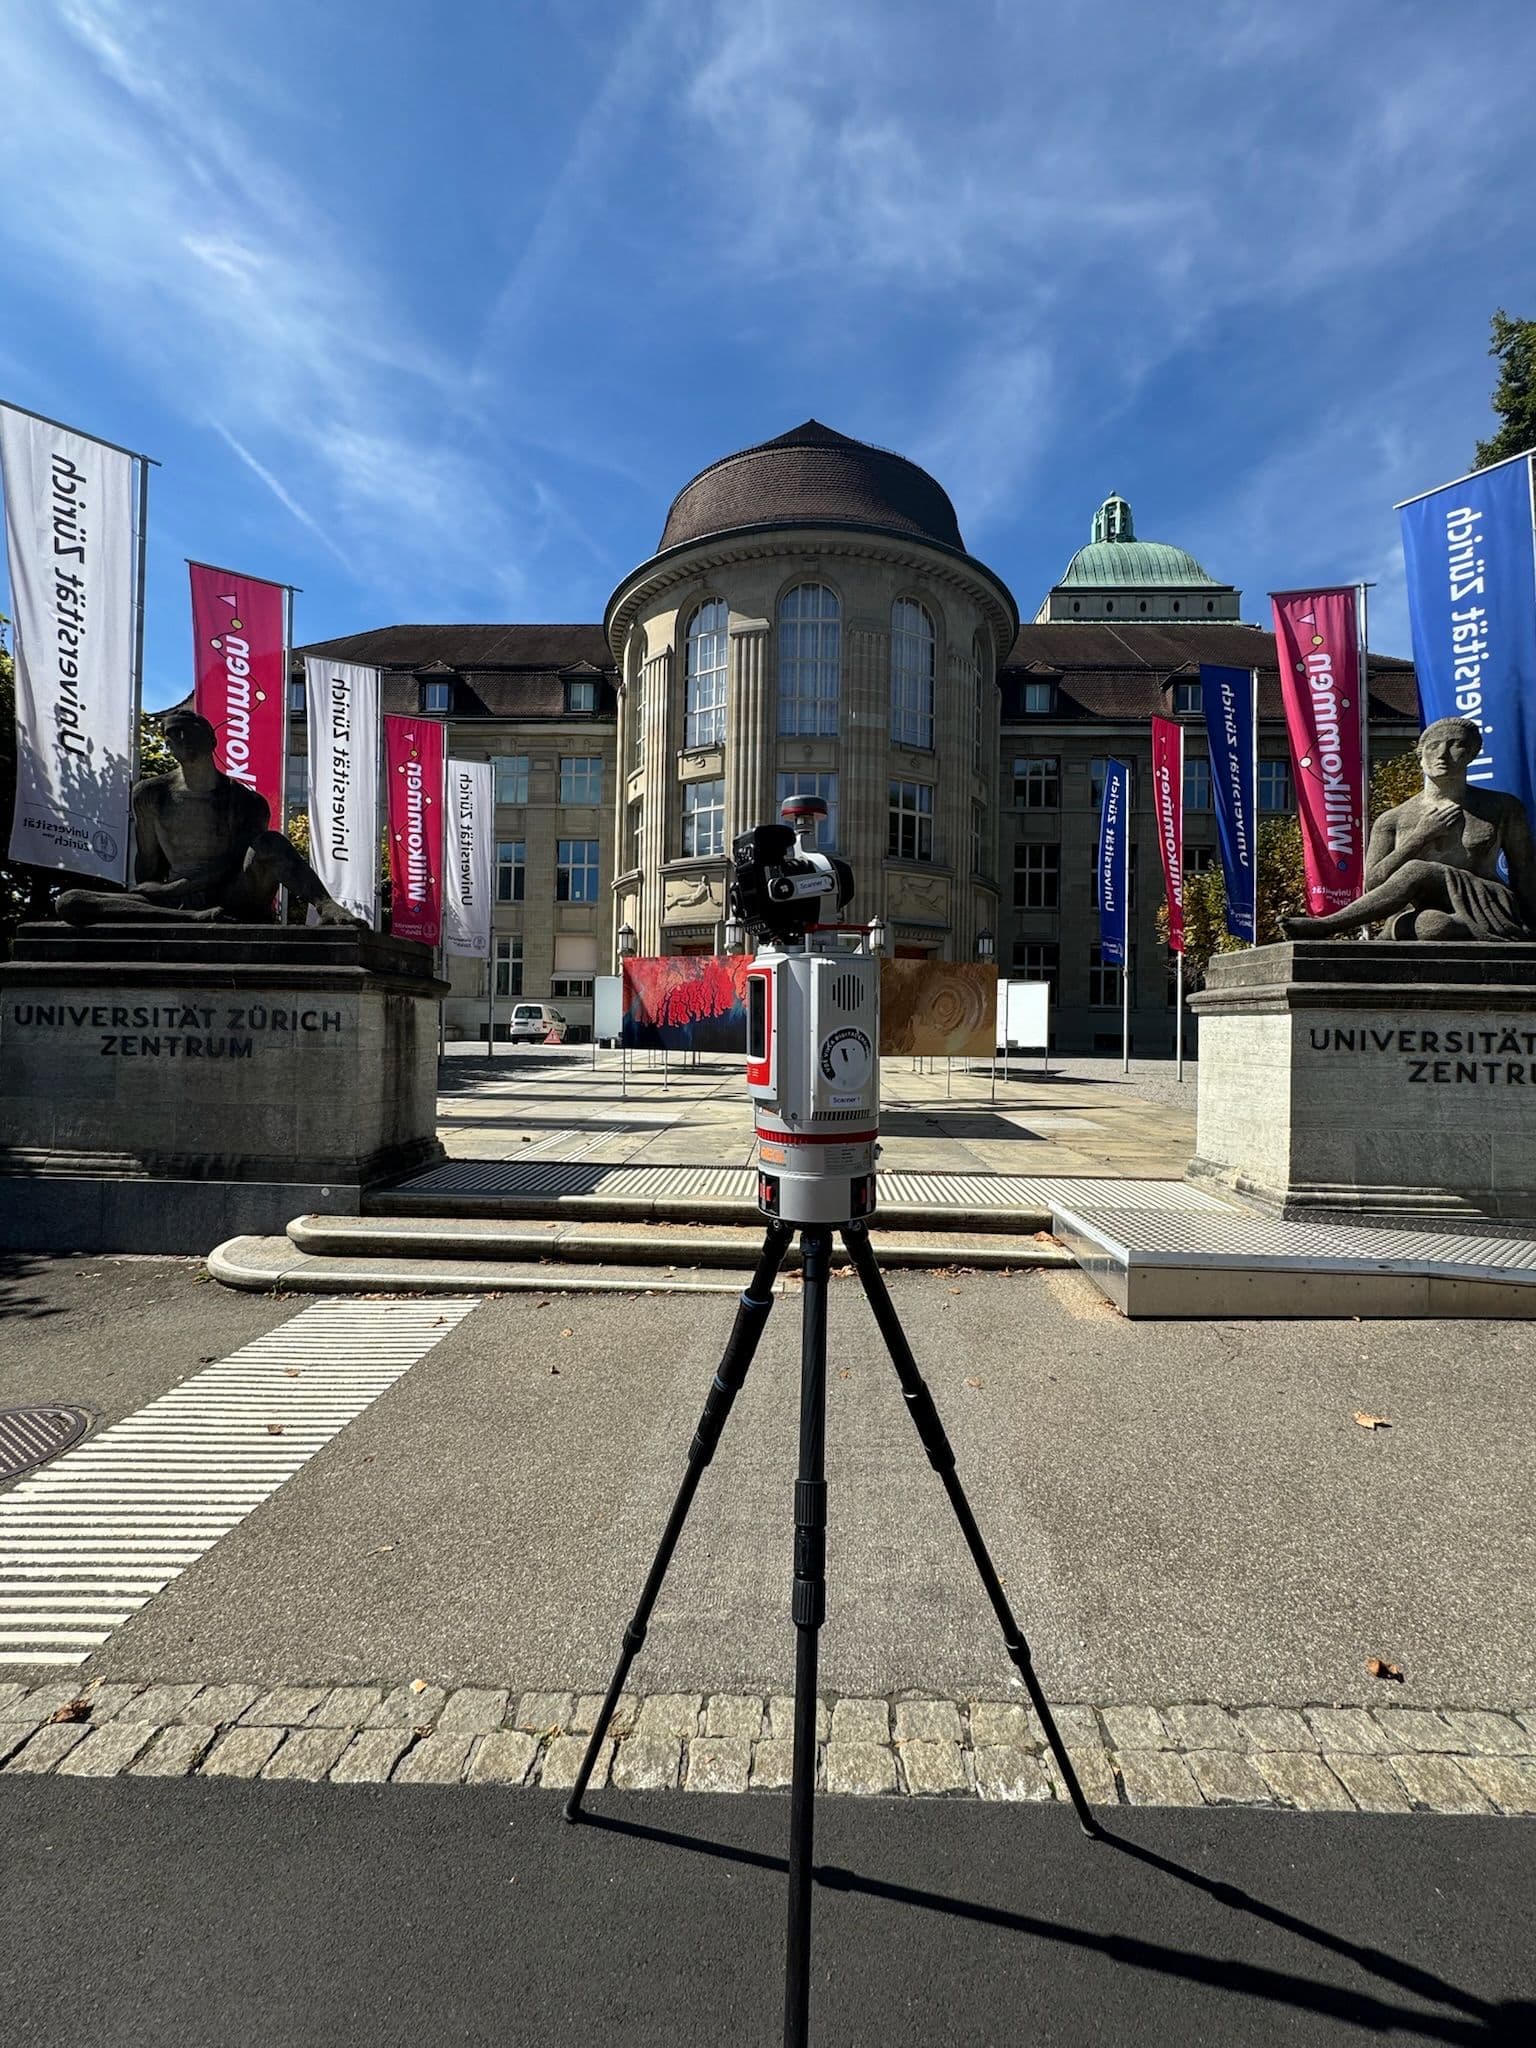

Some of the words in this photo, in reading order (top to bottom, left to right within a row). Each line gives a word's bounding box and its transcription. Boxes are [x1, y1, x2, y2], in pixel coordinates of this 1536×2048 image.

[14, 1003, 217, 1029] UNIVERSITÄT
[227, 1004, 342, 1032] ZÜRICH
[100, 1035, 253, 1058] ZENTRUM
[1310, 1027, 1536, 1055] UNIVERSITÄT
[1408, 1061, 1536, 1085] ZENTR
